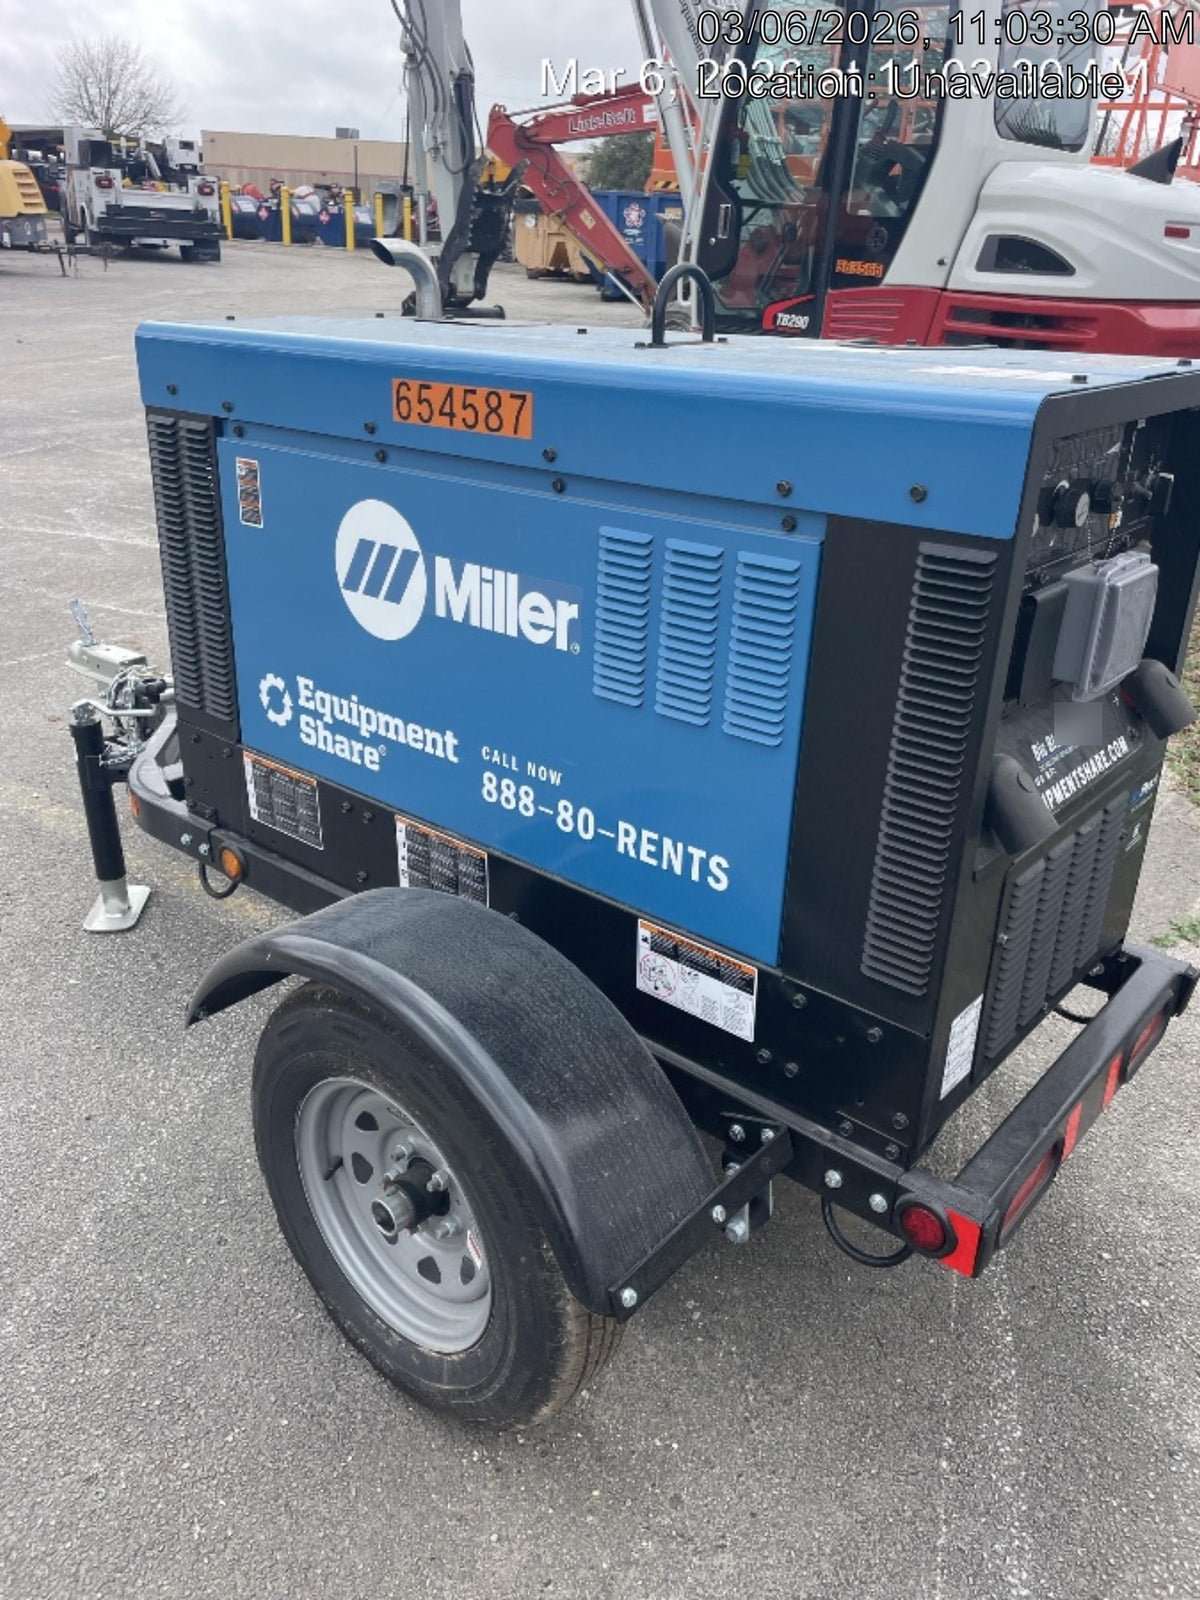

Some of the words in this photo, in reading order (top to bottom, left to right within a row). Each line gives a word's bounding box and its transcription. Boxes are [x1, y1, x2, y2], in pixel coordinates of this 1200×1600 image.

[569, 108, 636, 133] Link-Belt
[776, 312, 809, 330] TB290
[396, 381, 527, 435] 654587
[435, 555, 579, 651] Miller
[296, 674, 459, 764] Equipment
[299, 714, 381, 772] Share
[481, 746, 519, 771] CALL
[527, 761, 562, 786] NOW
[1041, 735, 1129, 810] IPMENTSHARE.COM
[481, 771, 730, 892] 888-80-RENTS
